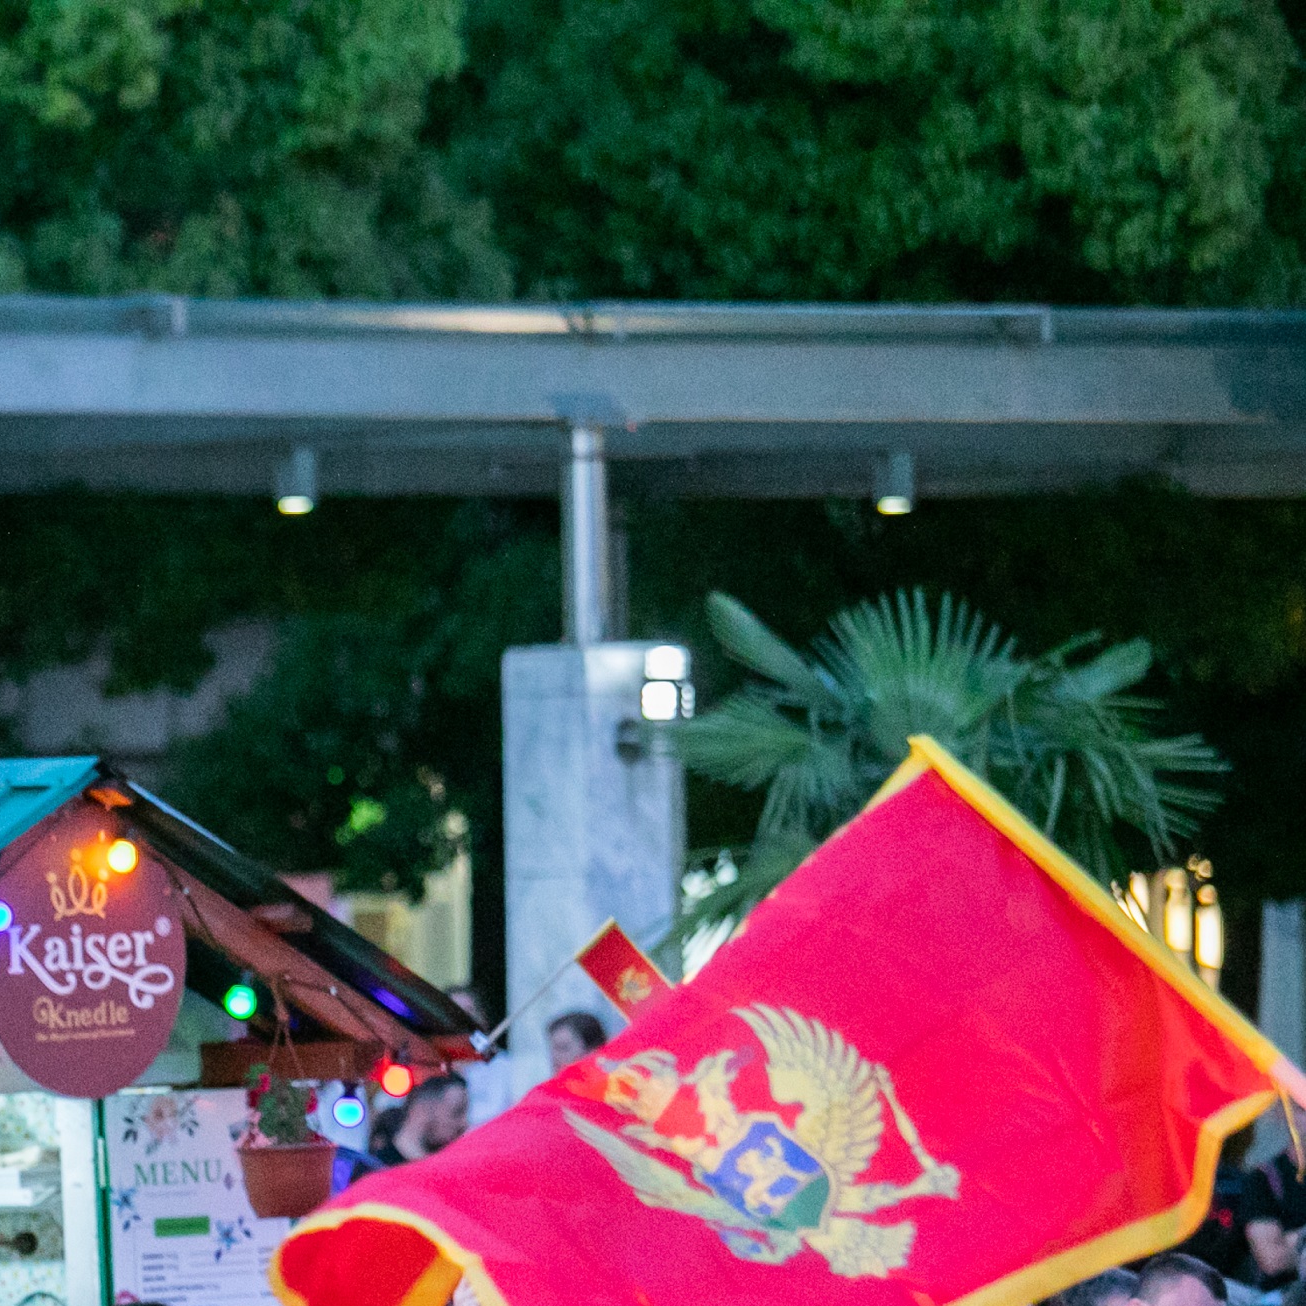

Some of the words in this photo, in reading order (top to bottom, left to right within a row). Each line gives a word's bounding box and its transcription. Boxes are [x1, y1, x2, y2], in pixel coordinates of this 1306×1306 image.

[7, 923, 175, 1009] Kaiser
[32, 996, 130, 1028] Knedle
[132, 1158, 222, 1187] MENU
